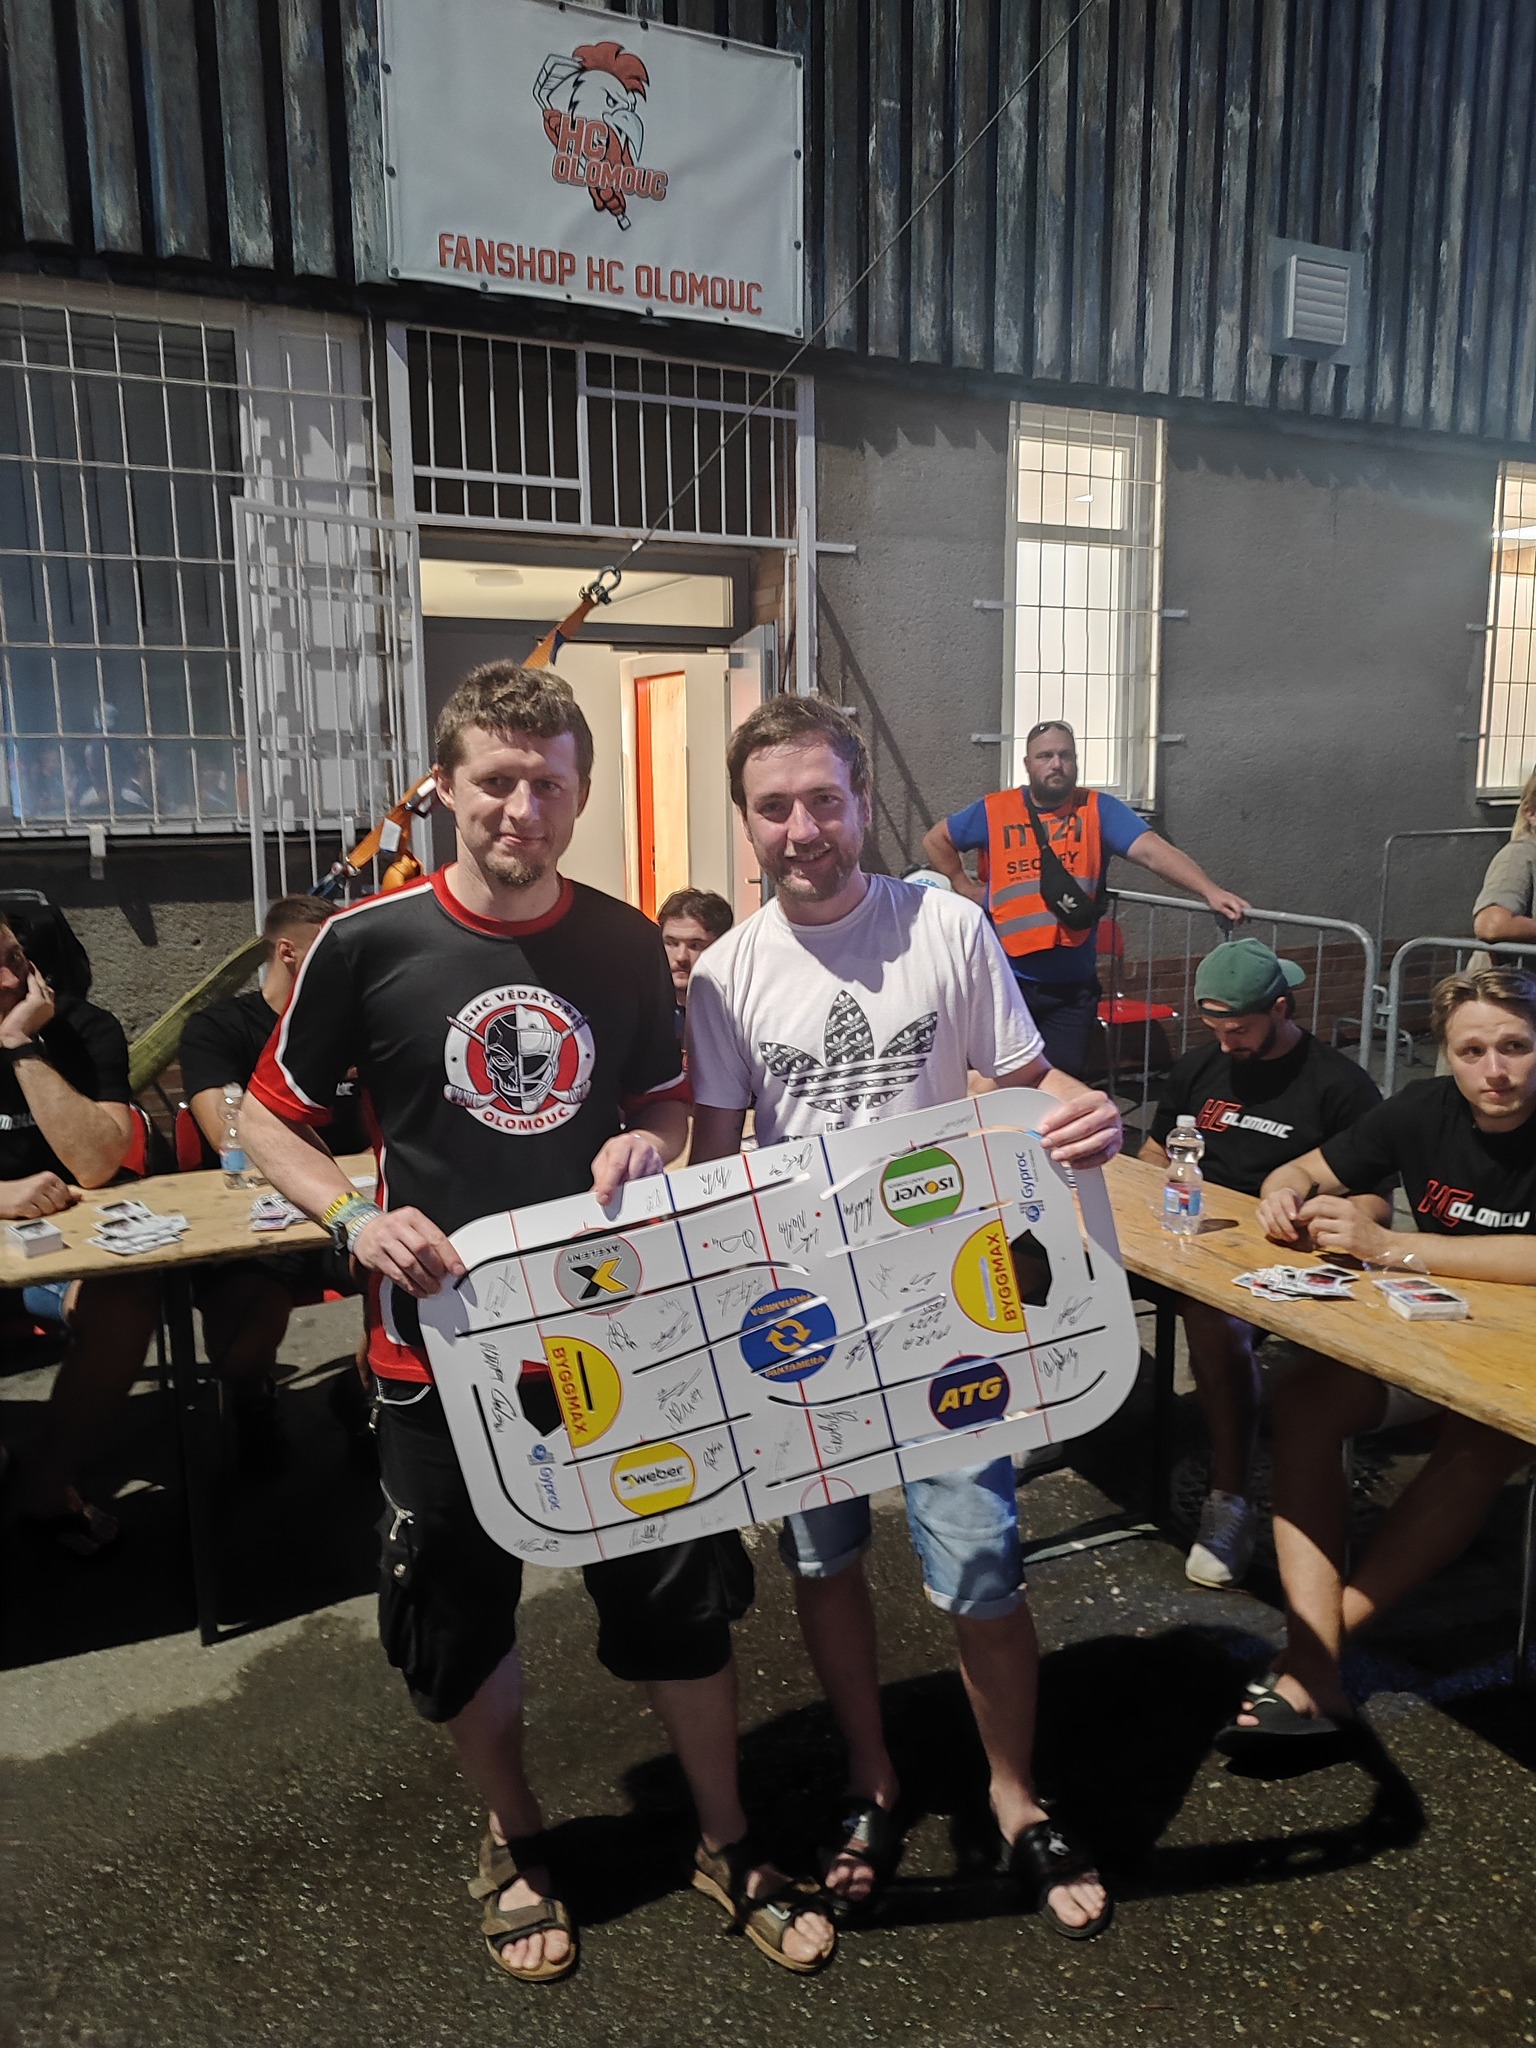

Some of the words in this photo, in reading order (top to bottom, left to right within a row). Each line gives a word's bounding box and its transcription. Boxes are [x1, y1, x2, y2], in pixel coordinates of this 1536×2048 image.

[557, 115, 609, 160] HC
[551, 153, 669, 201] OLOMOUC
[438, 232, 576, 286] FANSHOP
[587, 256, 625, 295] HC
[635, 264, 763, 316] OLOMOUC
[483, 1106, 571, 1131] OLOMOUC
[1015, 1151, 1035, 1199] Gyproc
[986, 1232, 1018, 1322] BYGGMAX
[552, 1346, 588, 1435] BYGGMAX
[937, 1375, 1005, 1414] ATG
[538, 1467, 561, 1511] Gyproc
[629, 1465, 685, 1485] weber
